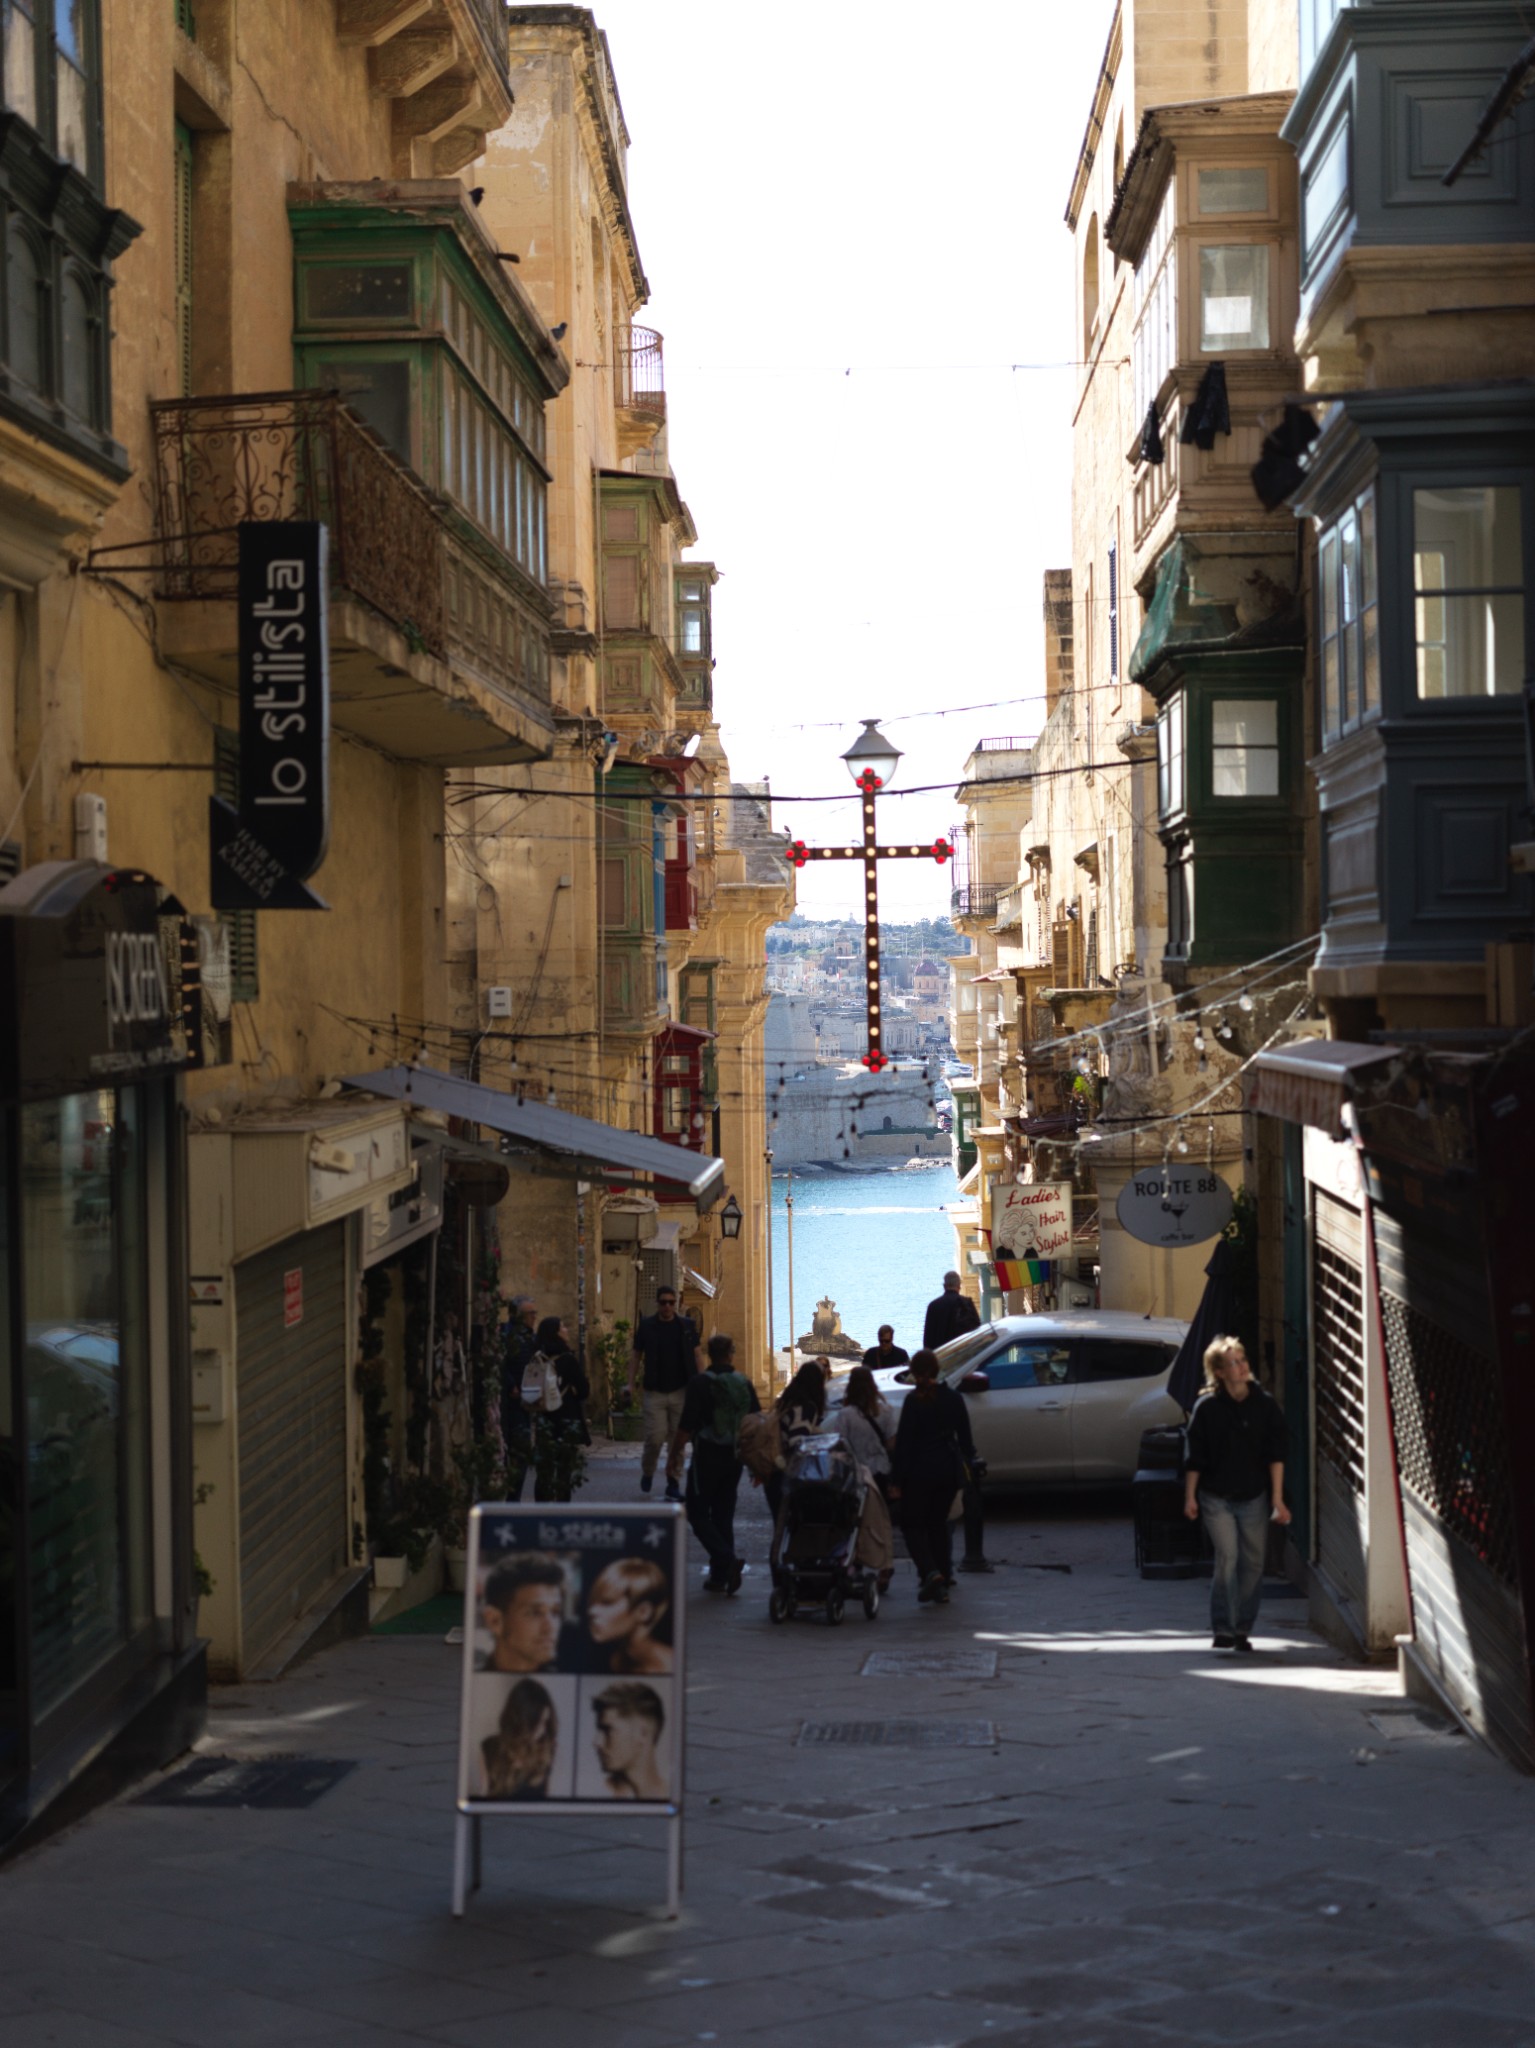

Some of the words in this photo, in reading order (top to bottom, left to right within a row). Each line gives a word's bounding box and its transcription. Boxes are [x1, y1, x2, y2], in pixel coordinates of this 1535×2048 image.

[252, 559, 307, 741] stilista
[254, 757, 307, 805] lo
[237, 828, 270, 861] HAIR
[1134, 1180, 1192, 1197] ROUTE
[1198, 1179, 1217, 1193] 88
[1039, 1211, 1066, 1227] Hair
[1036, 1230, 1069, 1255] Stylist
